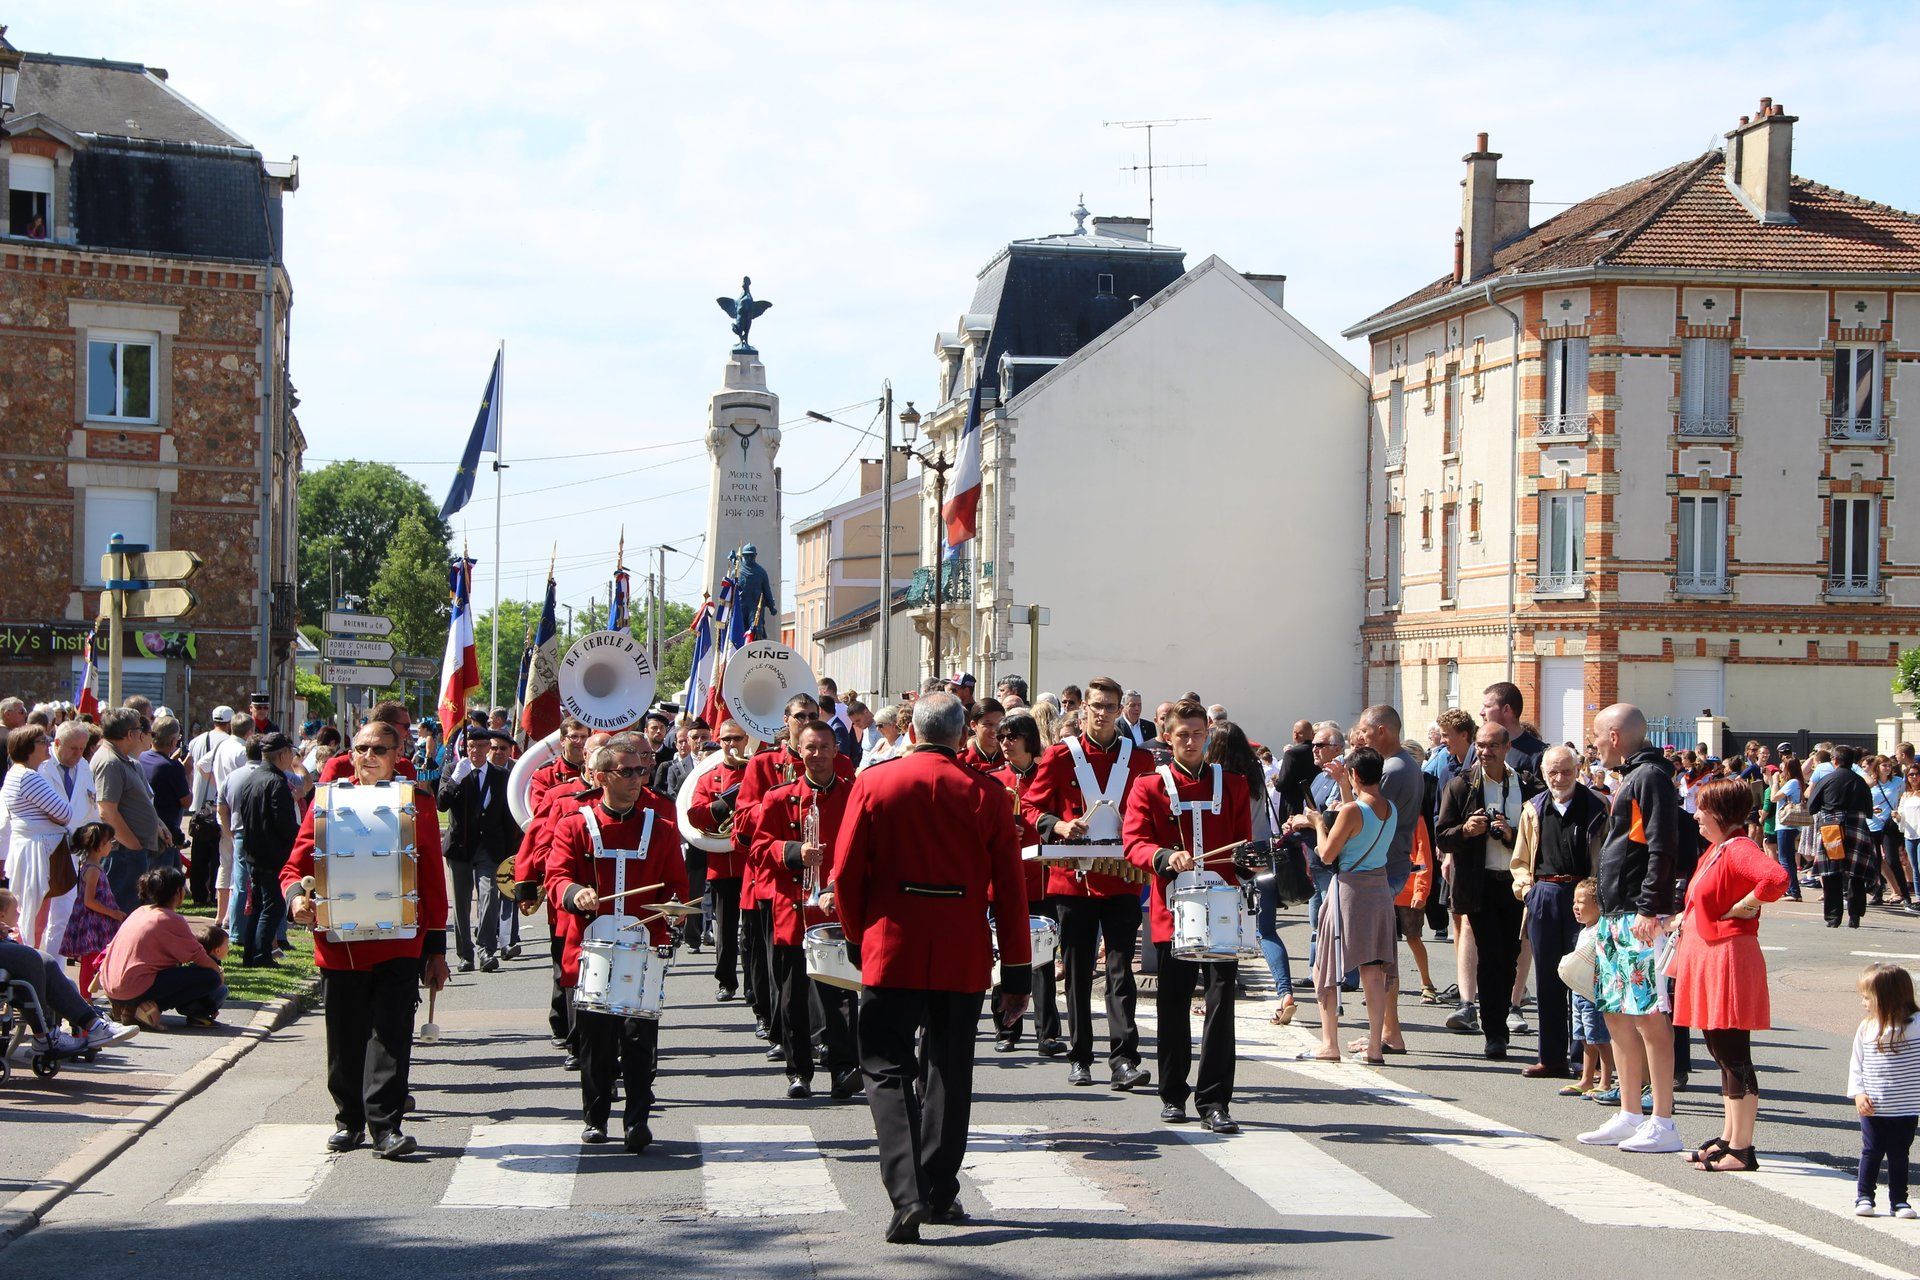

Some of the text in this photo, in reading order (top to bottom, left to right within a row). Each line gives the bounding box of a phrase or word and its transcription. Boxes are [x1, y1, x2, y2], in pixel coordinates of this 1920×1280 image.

[728, 469, 762, 479] MORTS
[731, 483, 758, 491] POUR
[721, 494, 768, 503] LA FRANCE
[343, 620, 368, 628] BRIENNE
[330, 641, 346, 649] ROME
[583, 635, 624, 651] CERCLE
[747, 650, 790, 660] KING
[566, 695, 583, 718] VITRY
[582, 712, 592, 724] LE
[627, 708, 637, 719] 51
[733, 697, 772, 736] CERCLE
